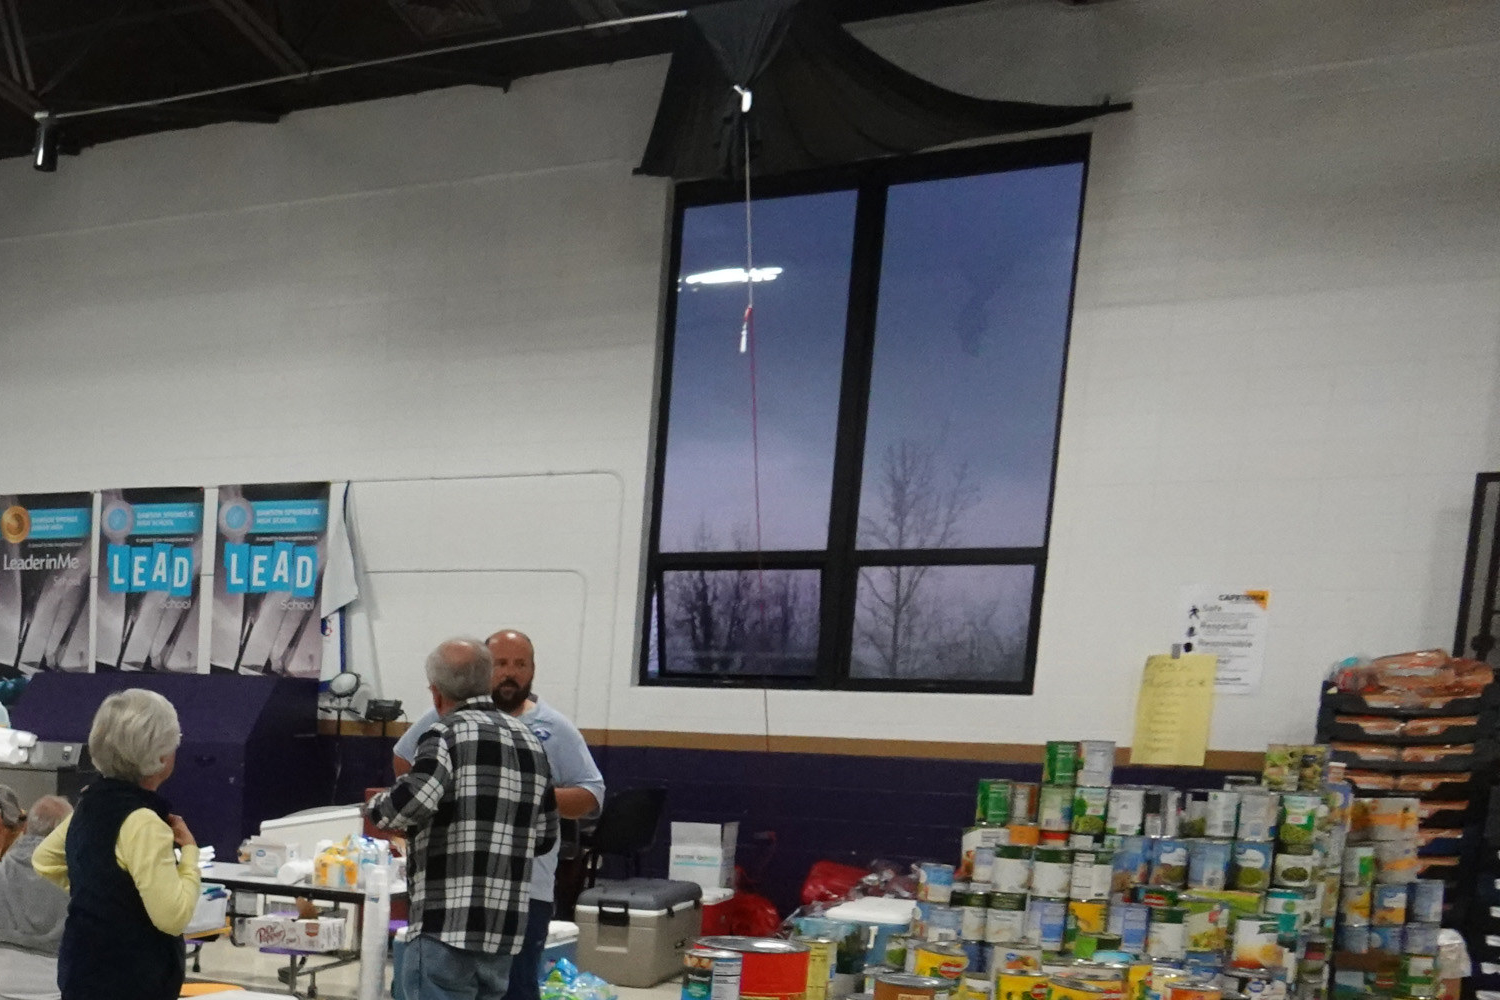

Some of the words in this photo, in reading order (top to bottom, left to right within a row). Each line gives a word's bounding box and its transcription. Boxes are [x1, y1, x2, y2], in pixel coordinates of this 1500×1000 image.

[112, 548, 190, 588] LEAD
[230, 550, 314, 588] LEAD
[160, 599, 191, 610] School
[281, 599, 315, 611] School
